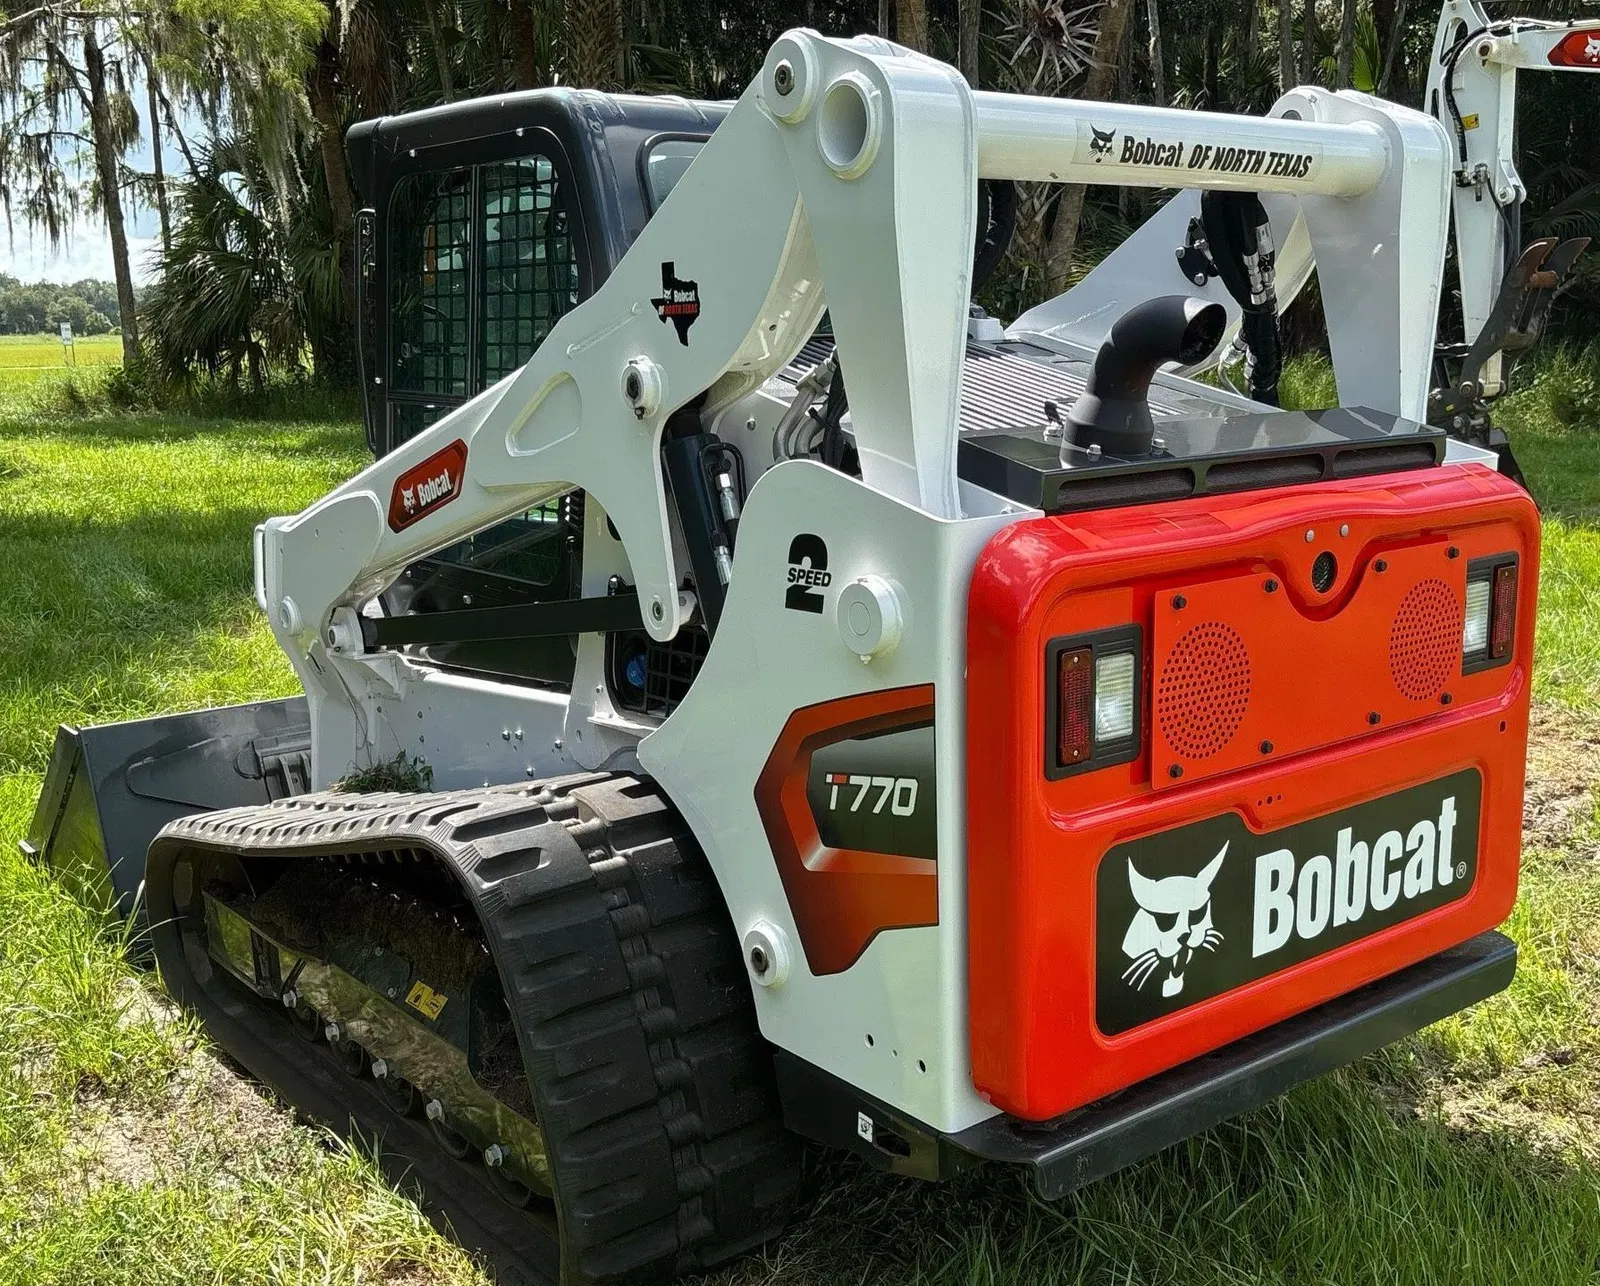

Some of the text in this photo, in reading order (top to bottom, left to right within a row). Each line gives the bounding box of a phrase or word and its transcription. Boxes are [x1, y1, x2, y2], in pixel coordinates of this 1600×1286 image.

[1119, 135, 1313, 179] Bobcat OF NORTH TEXAS
[664, 303, 682, 315] NORTH
[682, 302, 698, 314] TEXAS
[673, 289, 696, 303] Bobcat
[417, 468, 453, 507] Bobcat
[785, 533, 832, 615] 2 SPEED
[825, 773, 919, 817] T770
